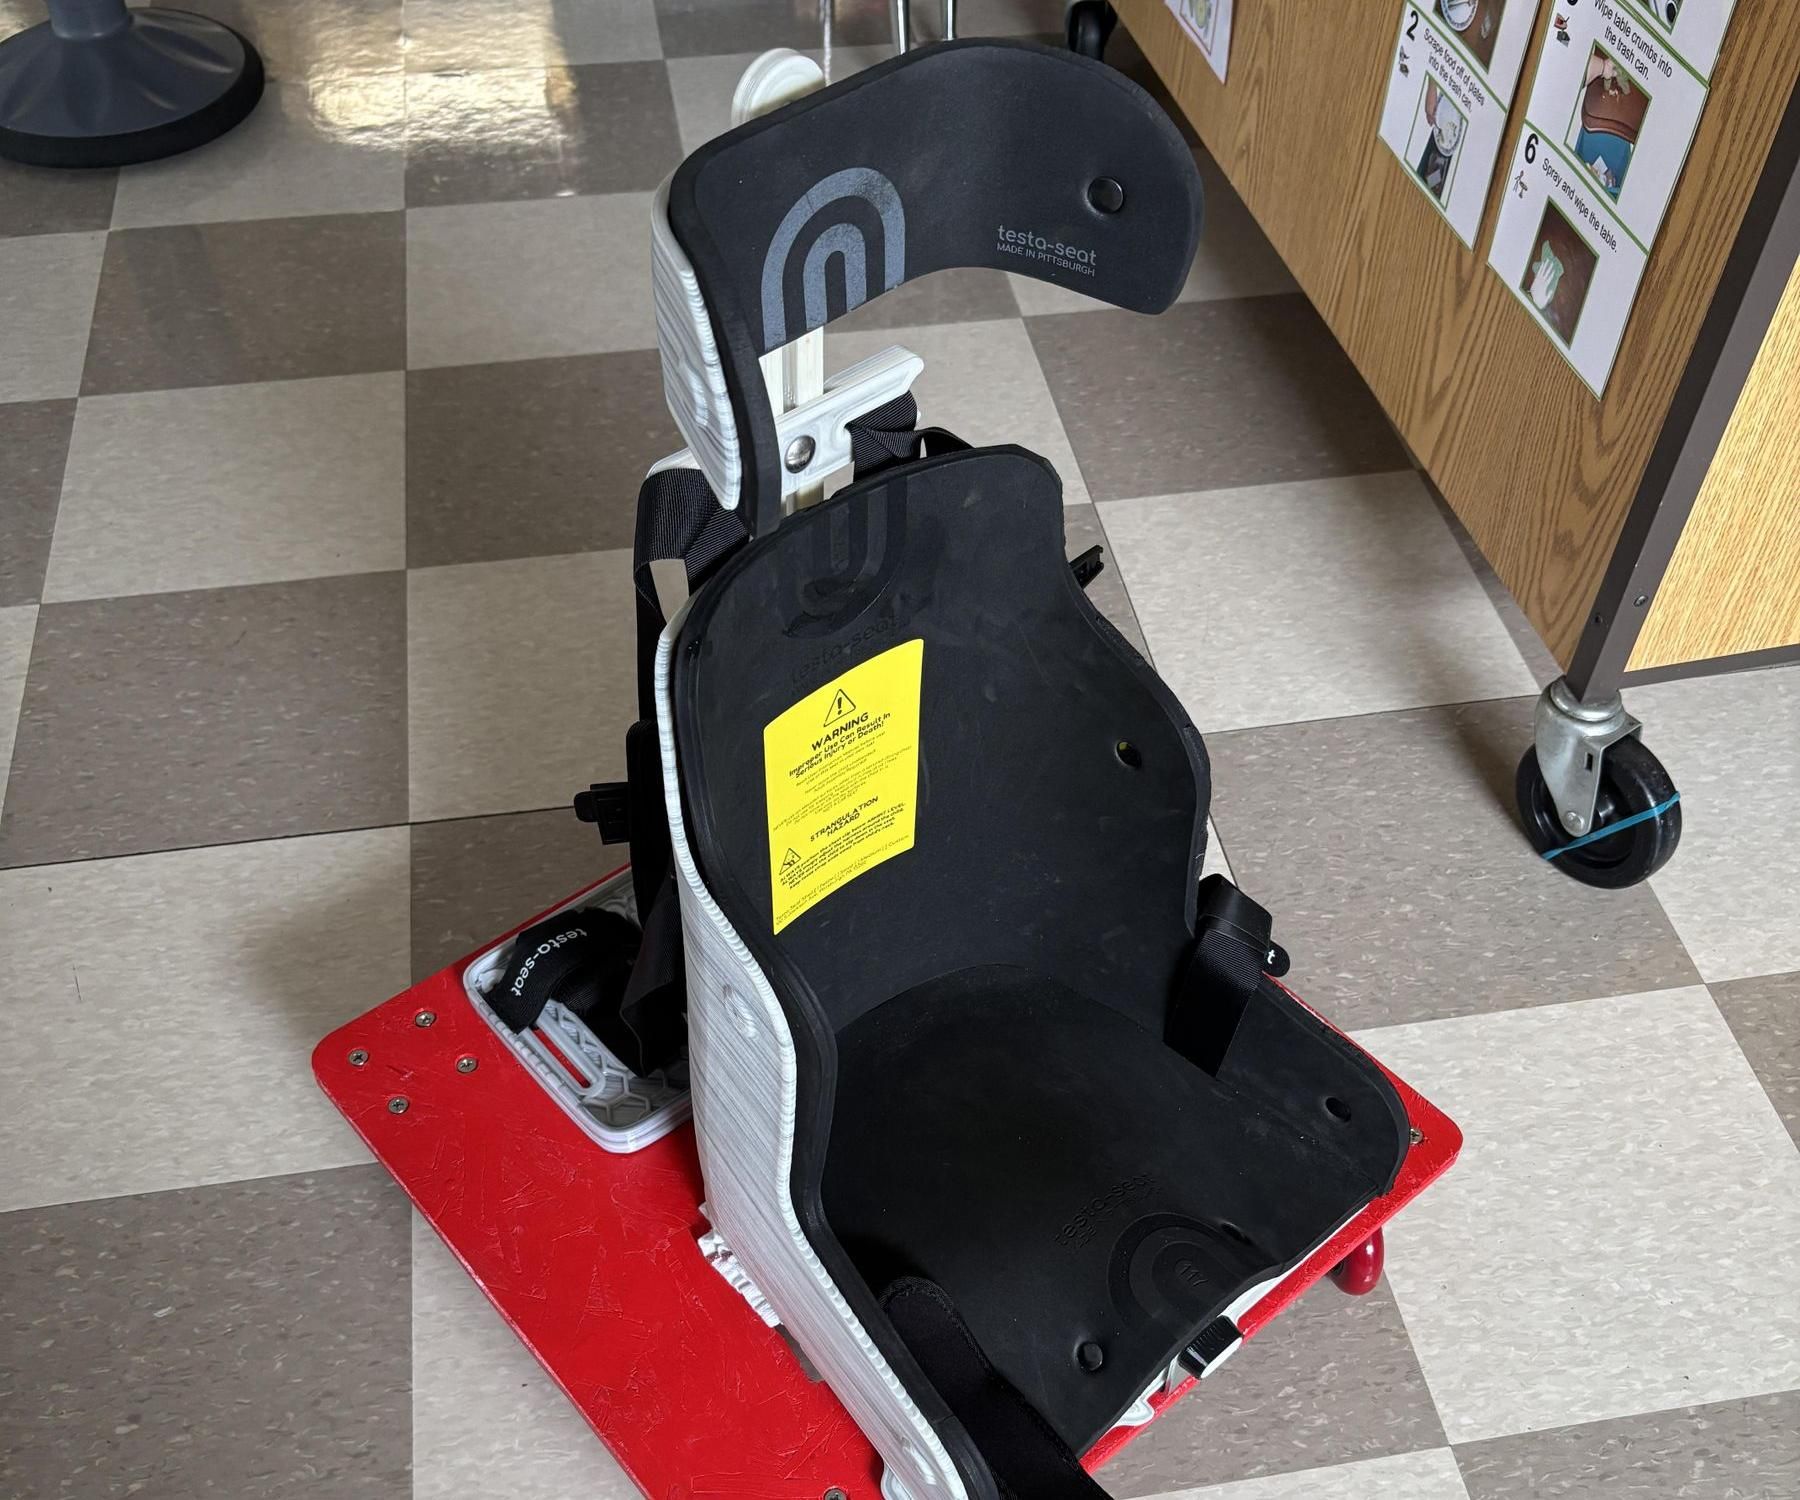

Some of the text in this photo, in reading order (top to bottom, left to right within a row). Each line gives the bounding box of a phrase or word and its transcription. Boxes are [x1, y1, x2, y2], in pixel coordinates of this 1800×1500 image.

[1406, 10, 1419, 42] 2
[1593, 0, 1673, 78] Wipe table crumbs into
[1604, 26, 1649, 80] the trash can.
[1423, 28, 1486, 106] Scrape food off of plates
[1428, 51, 1472, 113] into the trash can.
[1524, 133, 1539, 165] 6
[1542, 158, 1618, 253] Spray and wipe the table.
[996, 242, 1096, 277] MADE IN PITTSBURGH
[997, 224, 1097, 266] testa-seat
[789, 751, 822, 776] Improper
[824, 740, 837, 752] Use
[839, 730, 854, 743] Can
[856, 714, 881, 734] Result
[796, 757, 822, 778] Serious
[824, 741, 845, 760] Injury
[847, 736, 855, 744] or
[857, 720, 883, 739] Death!
[811, 712, 869, 751] WARNING
[810, 795, 878, 842] STRANGULATION
[827, 813, 859, 835] HAZARD
[510, 928, 588, 997] testa-seat
